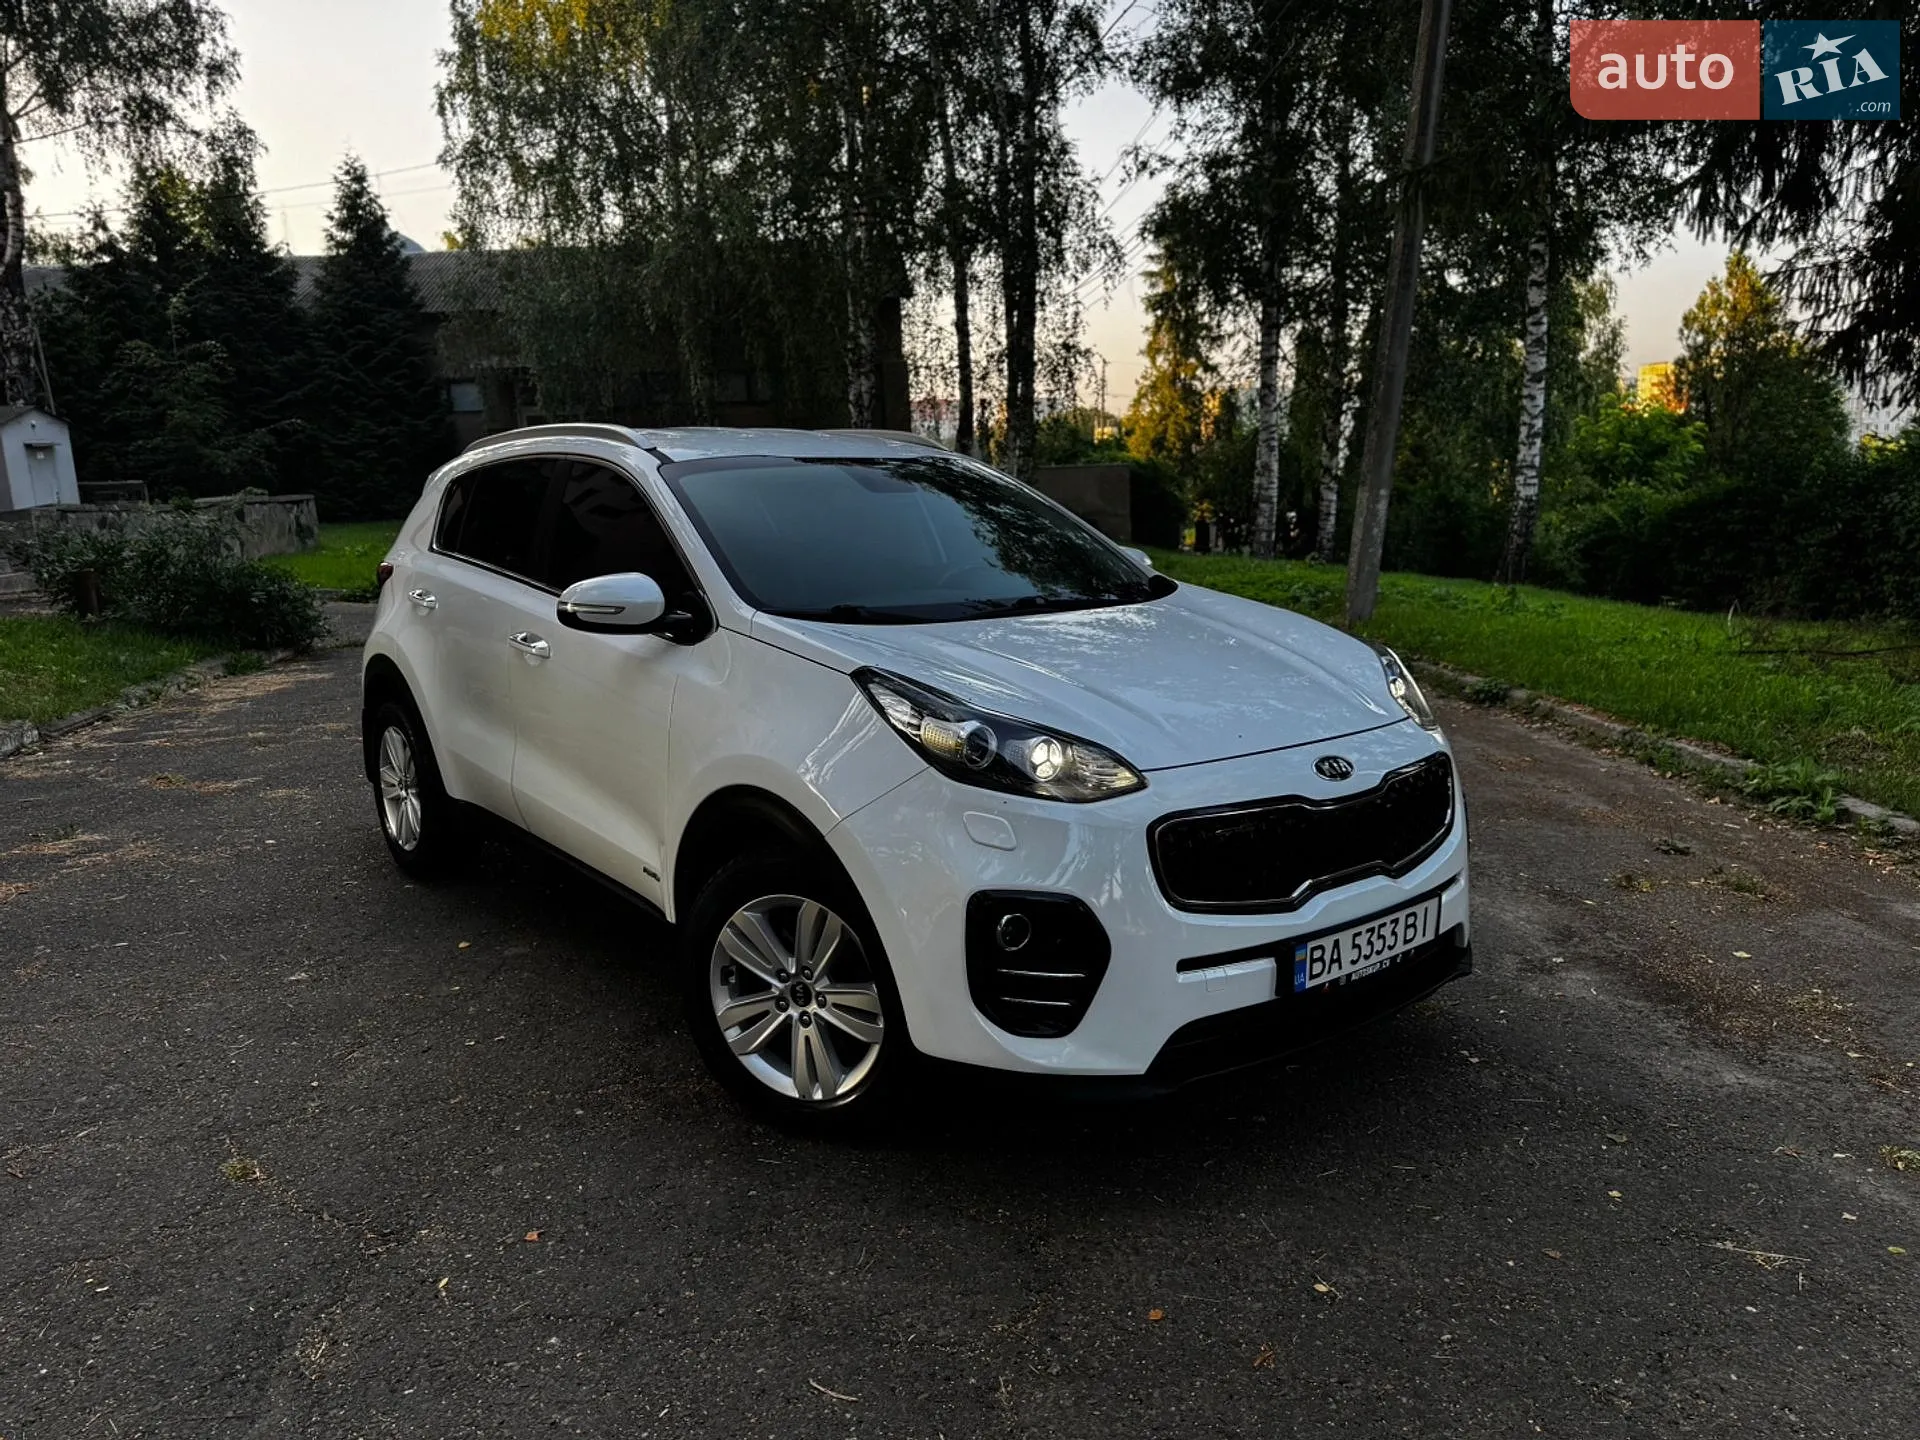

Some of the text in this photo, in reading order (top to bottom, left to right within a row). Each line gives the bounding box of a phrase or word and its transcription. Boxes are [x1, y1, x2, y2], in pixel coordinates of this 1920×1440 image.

[1317, 759, 1352, 776] KIA
[1309, 906, 1428, 981] BA 5353 BI
